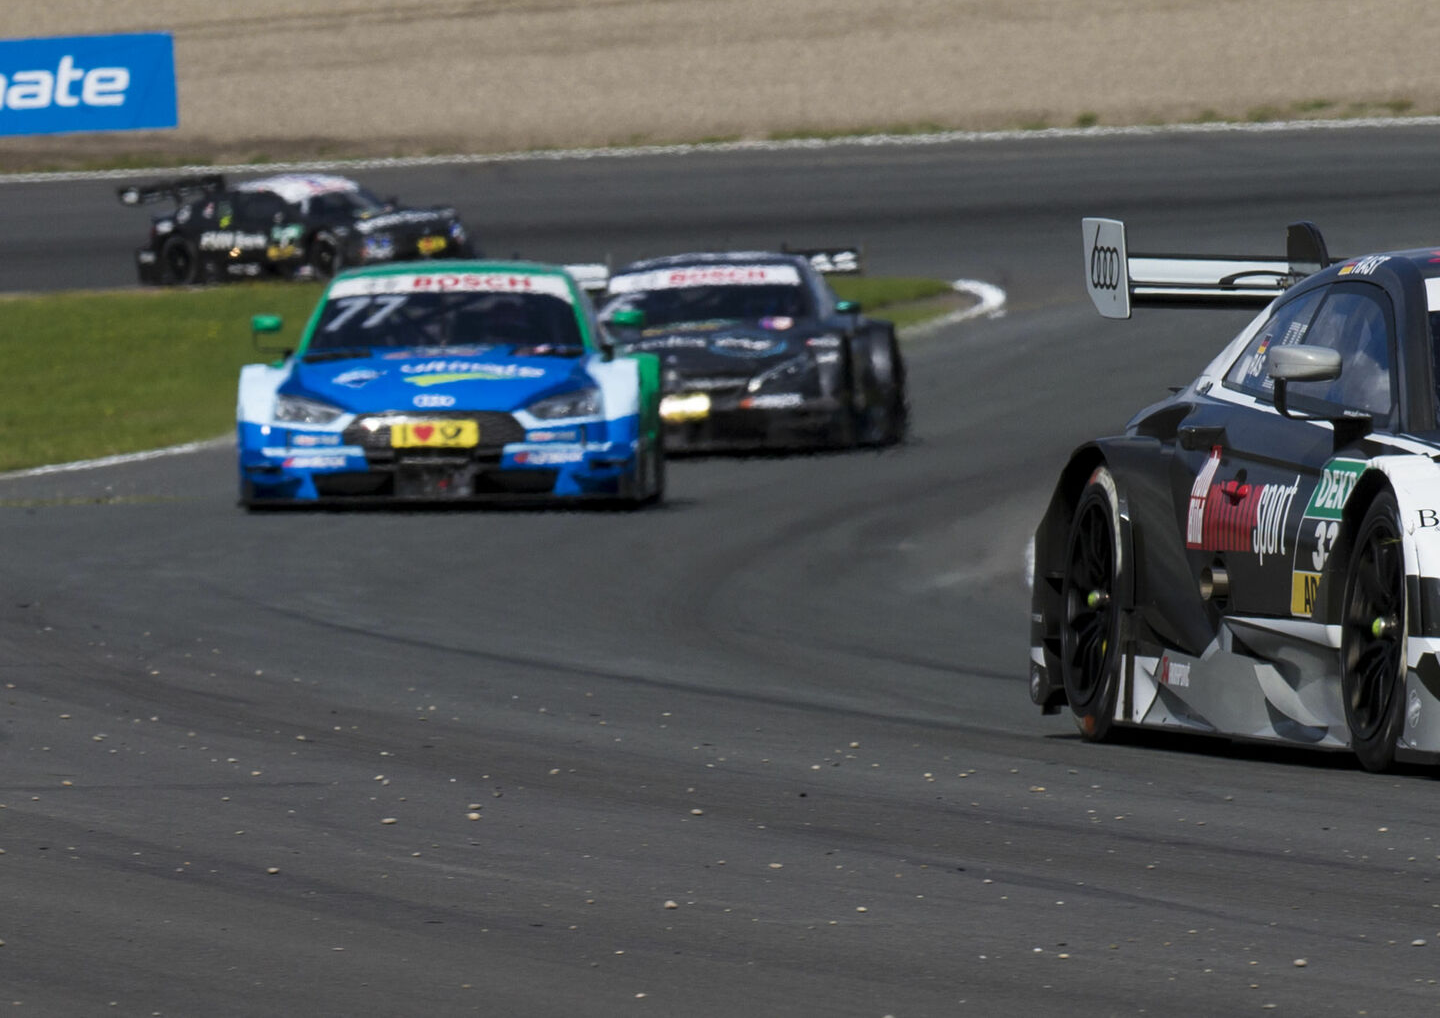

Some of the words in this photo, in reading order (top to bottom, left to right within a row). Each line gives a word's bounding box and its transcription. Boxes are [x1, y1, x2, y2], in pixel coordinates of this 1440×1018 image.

[0, 55, 131, 111] ate
[412, 274, 532, 289] BOSCH
[324, 295, 409, 332] 77
